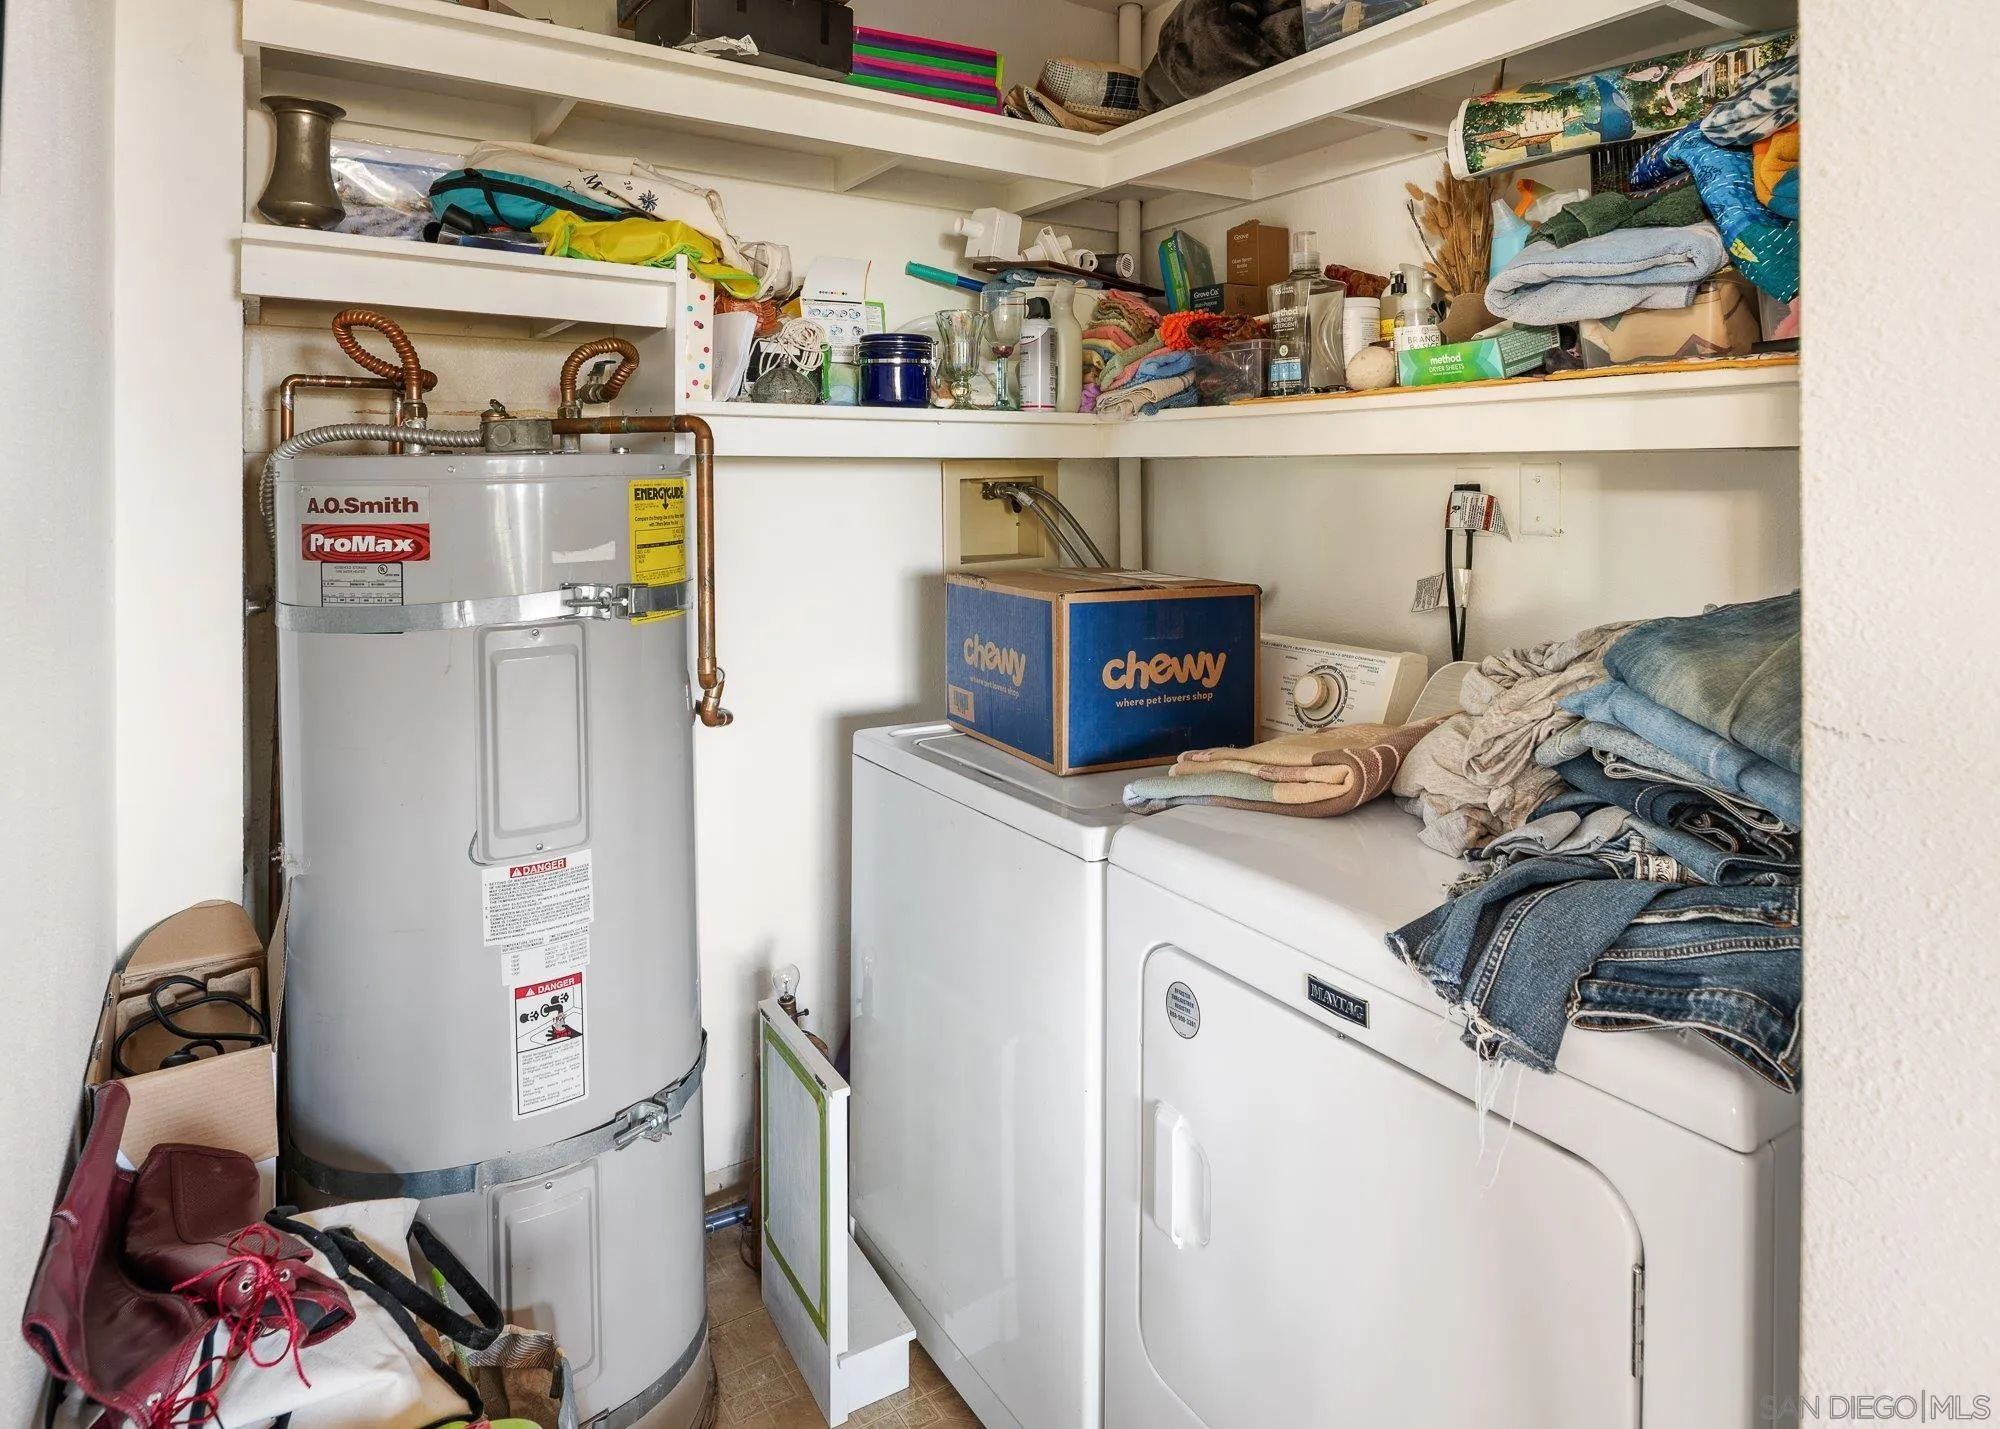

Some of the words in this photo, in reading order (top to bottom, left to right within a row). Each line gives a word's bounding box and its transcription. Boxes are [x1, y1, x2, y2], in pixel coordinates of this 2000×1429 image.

[1408, 335, 1440, 344] BRANCH
[1430, 352, 1462, 365] method
[1446, 363, 1464, 371] SHEETS
[310, 533, 414, 553] ProMax
[963, 633, 1026, 687] chewy
[1102, 650, 1227, 690] chewy
[1115, 698, 1147, 708] where
[1146, 695, 1162, 707] pet
[1163, 694, 1191, 704] lovers
[1192, 691, 1213, 701] shop
[523, 859, 565, 875] DANGER
[537, 977, 575, 994] DANGER
[1311, 983, 1364, 1019] MAYTAG
